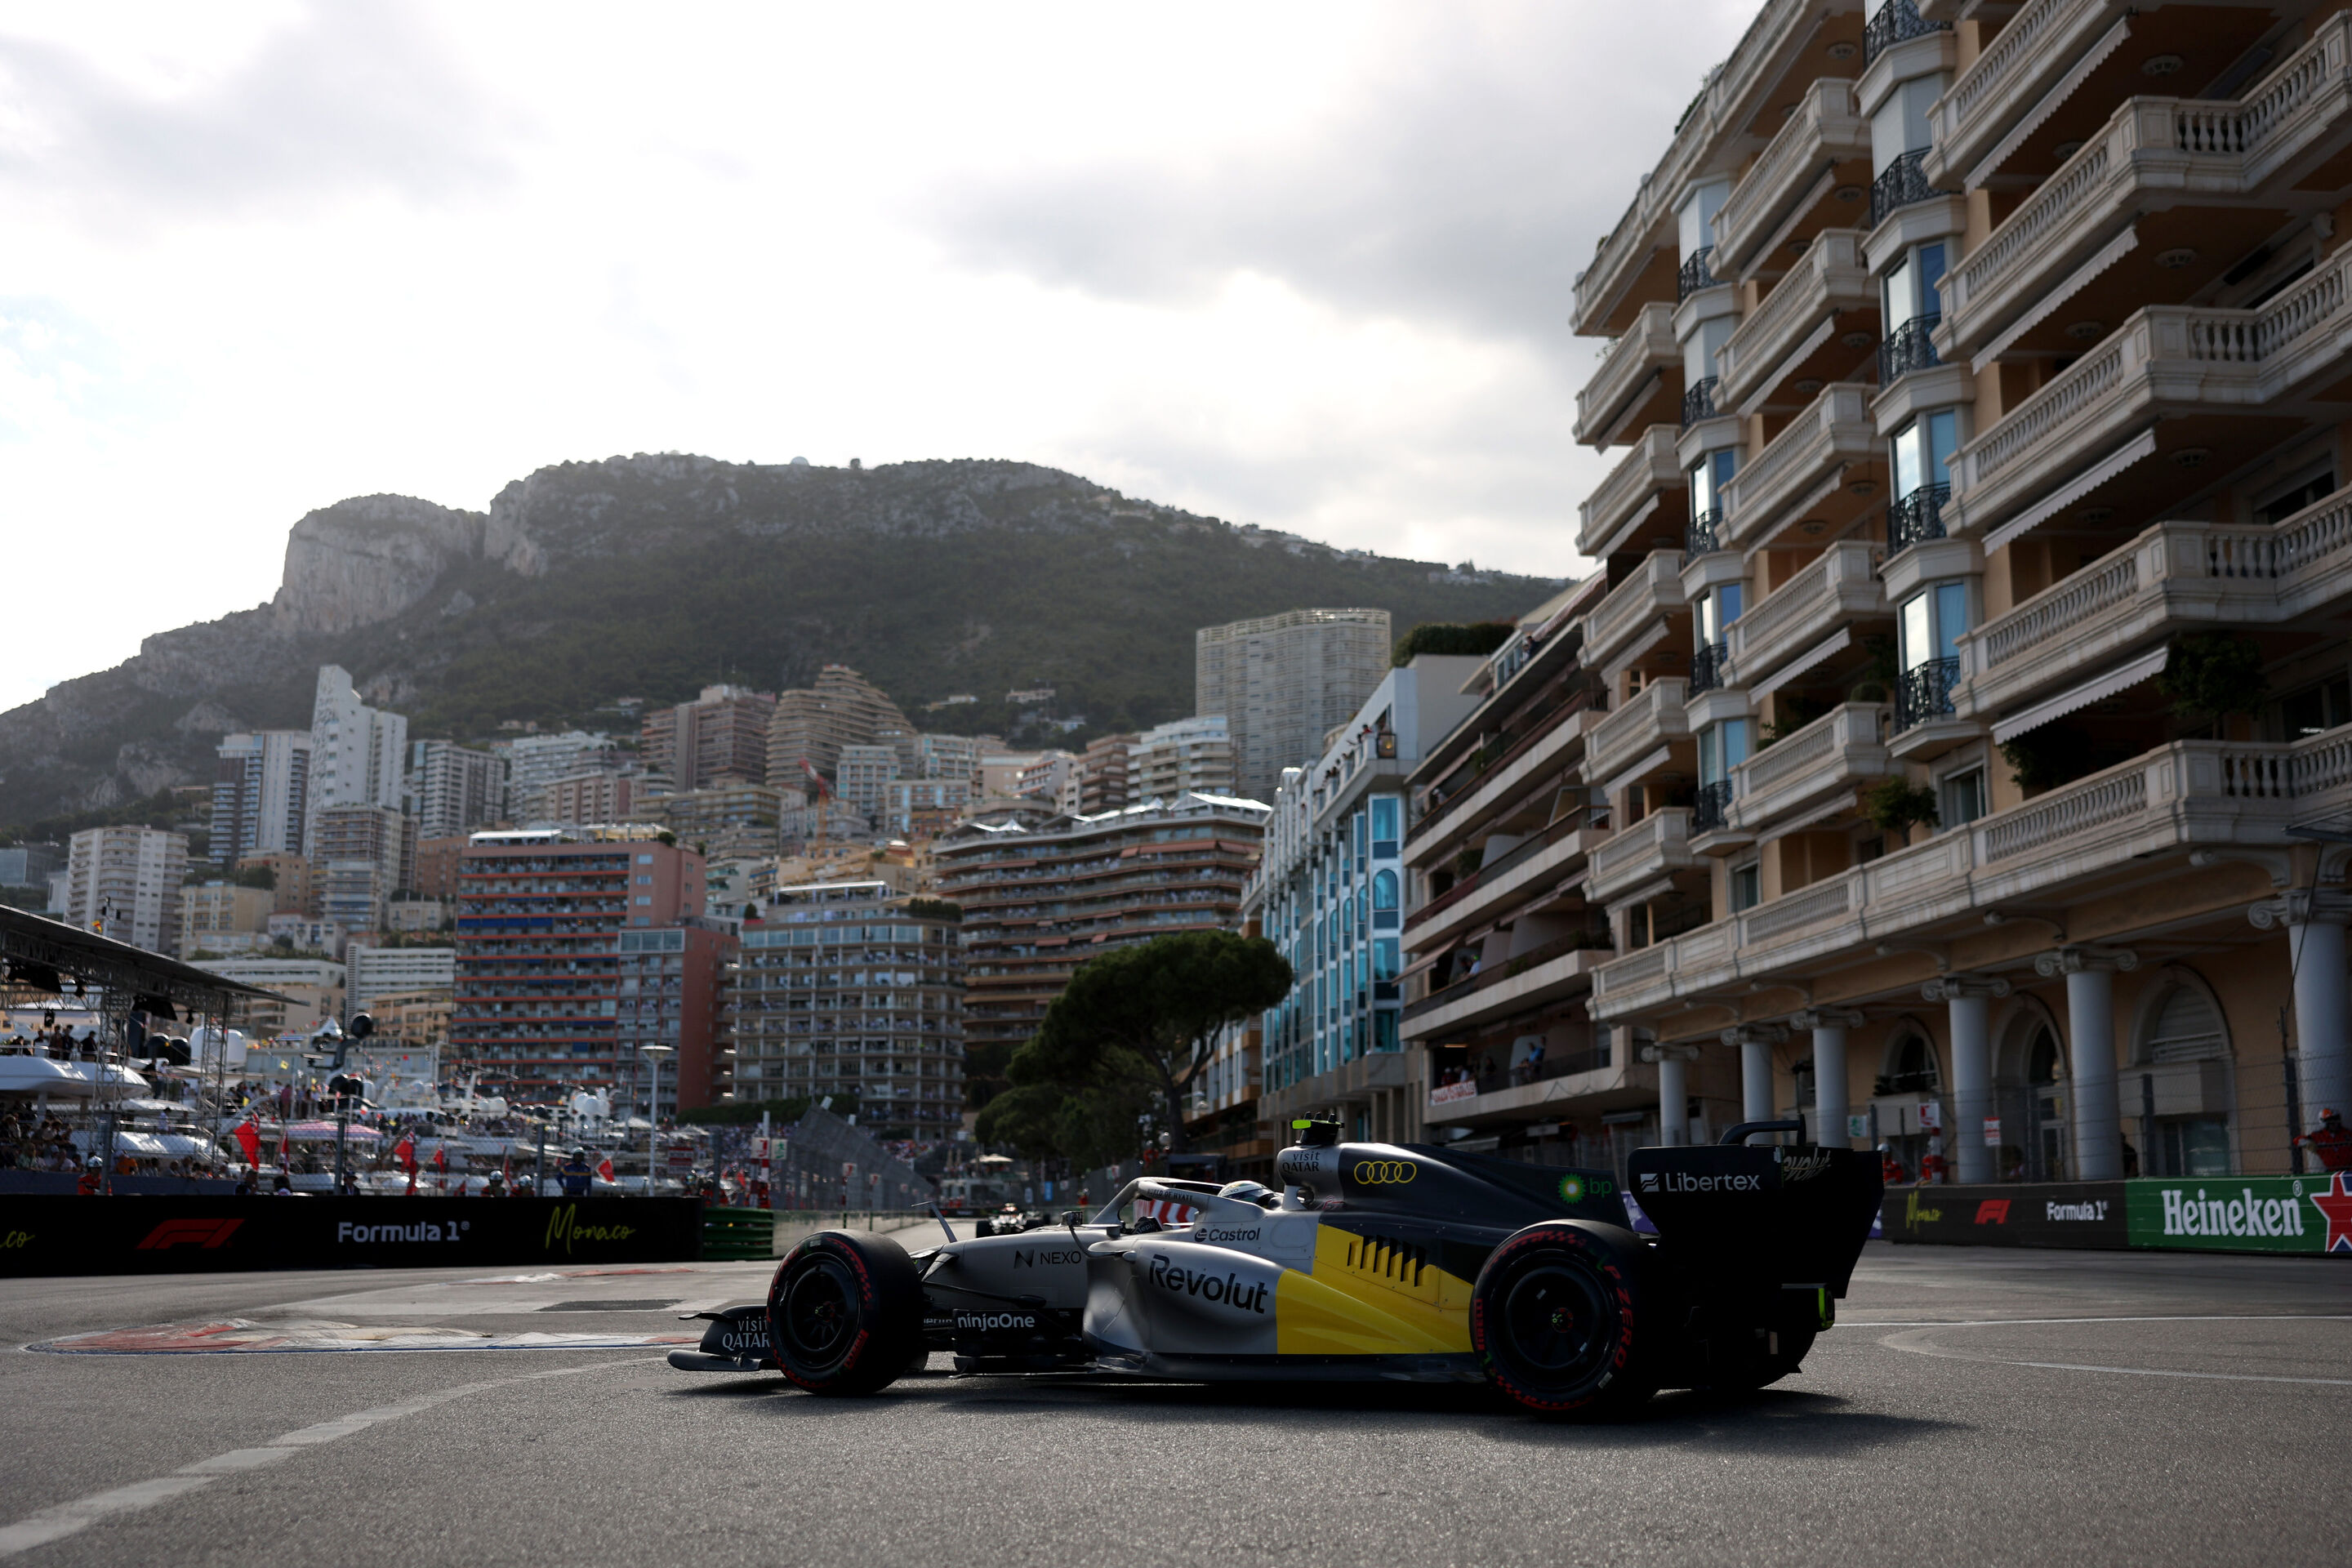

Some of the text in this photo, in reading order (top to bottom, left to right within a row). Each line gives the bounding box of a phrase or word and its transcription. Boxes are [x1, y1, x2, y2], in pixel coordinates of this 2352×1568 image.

[1294, 1151, 1320, 1161] visit
[1784, 1147, 1832, 1182] evolut
[1282, 1161, 1319, 1174] QATAR
[1589, 1177, 1613, 1199] bp
[1665, 1172, 1761, 1192] Libertex
[2047, 1200, 2094, 1222] Formula
[337, 1221, 441, 1243] Formula
[545, 1203, 636, 1254] Monaco
[1209, 1227, 1261, 1242] Castrol
[1040, 1250, 1081, 1265] NEXO
[1149, 1254, 1268, 1314] Revolut
[737, 1316, 768, 1332] visit
[957, 1312, 1036, 1332] ninjaOne
[722, 1332, 770, 1352] QATAR
